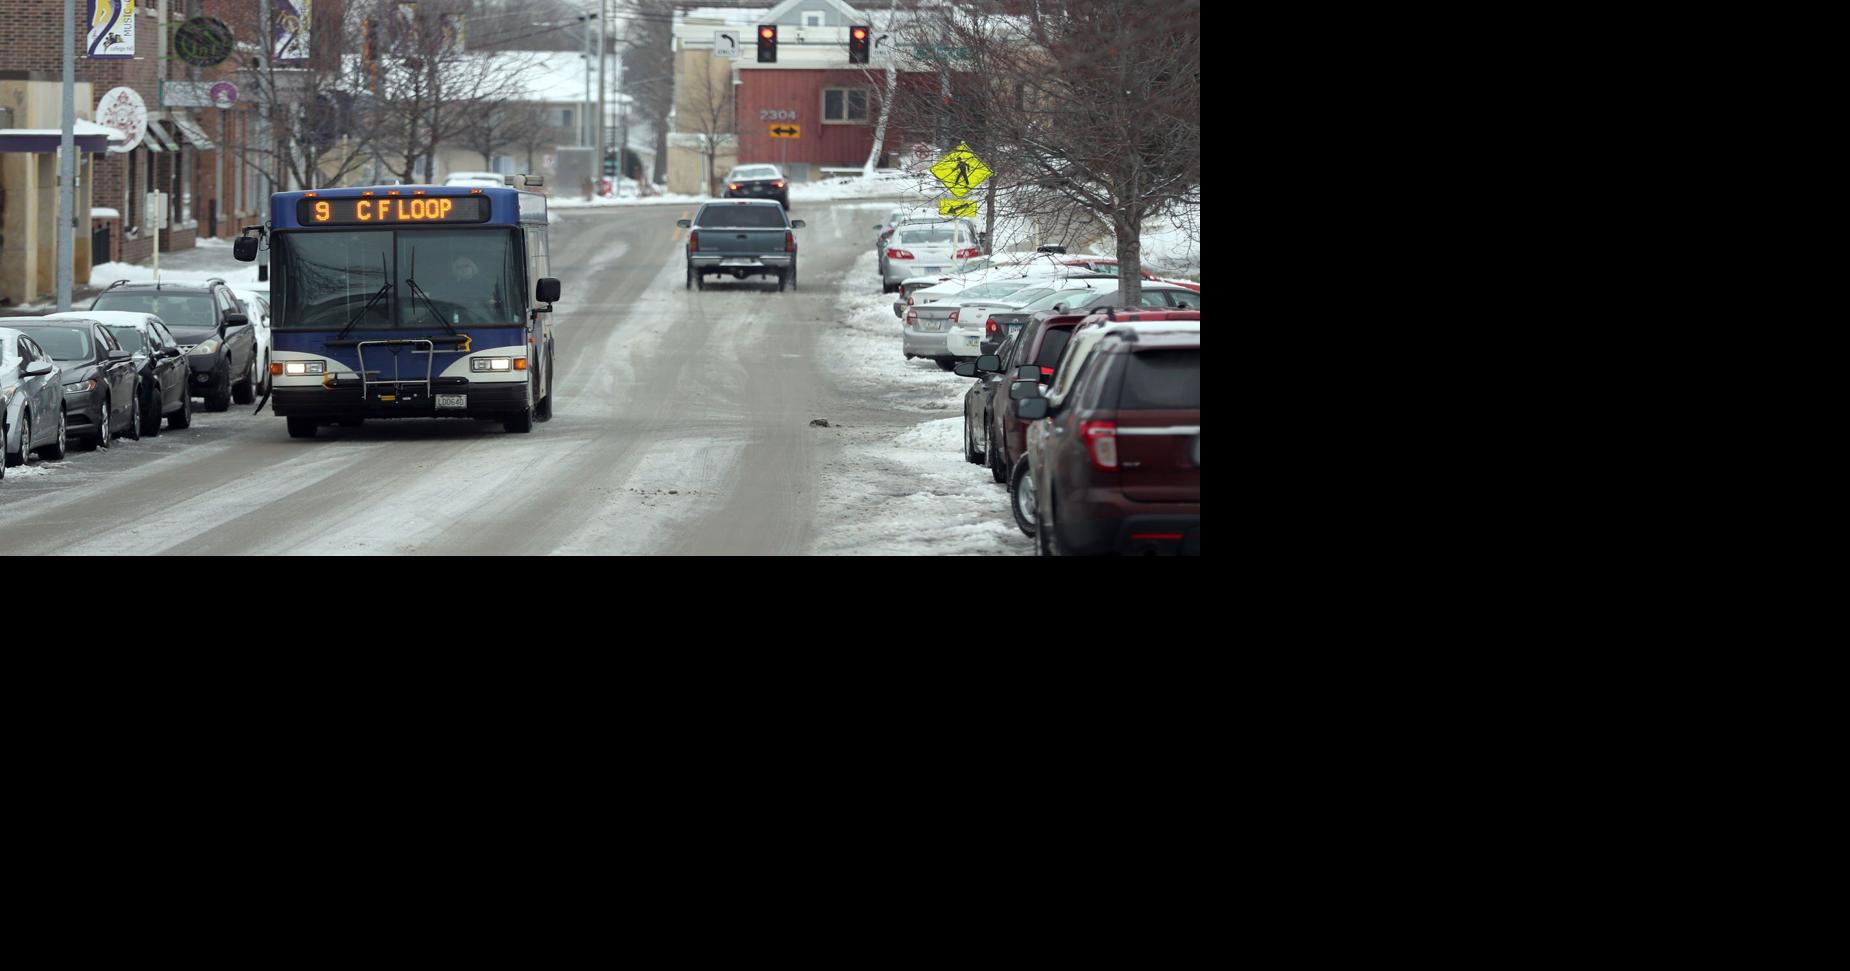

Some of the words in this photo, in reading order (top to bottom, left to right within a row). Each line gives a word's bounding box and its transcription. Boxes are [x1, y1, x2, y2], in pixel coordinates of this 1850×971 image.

[123, 8, 132, 36] MUSIC
[760, 111, 796, 120] 2304
[315, 201, 330, 221] 9
[357, 200, 371, 220] C
[378, 200, 391, 220] F
[398, 199, 452, 219] LOOP
